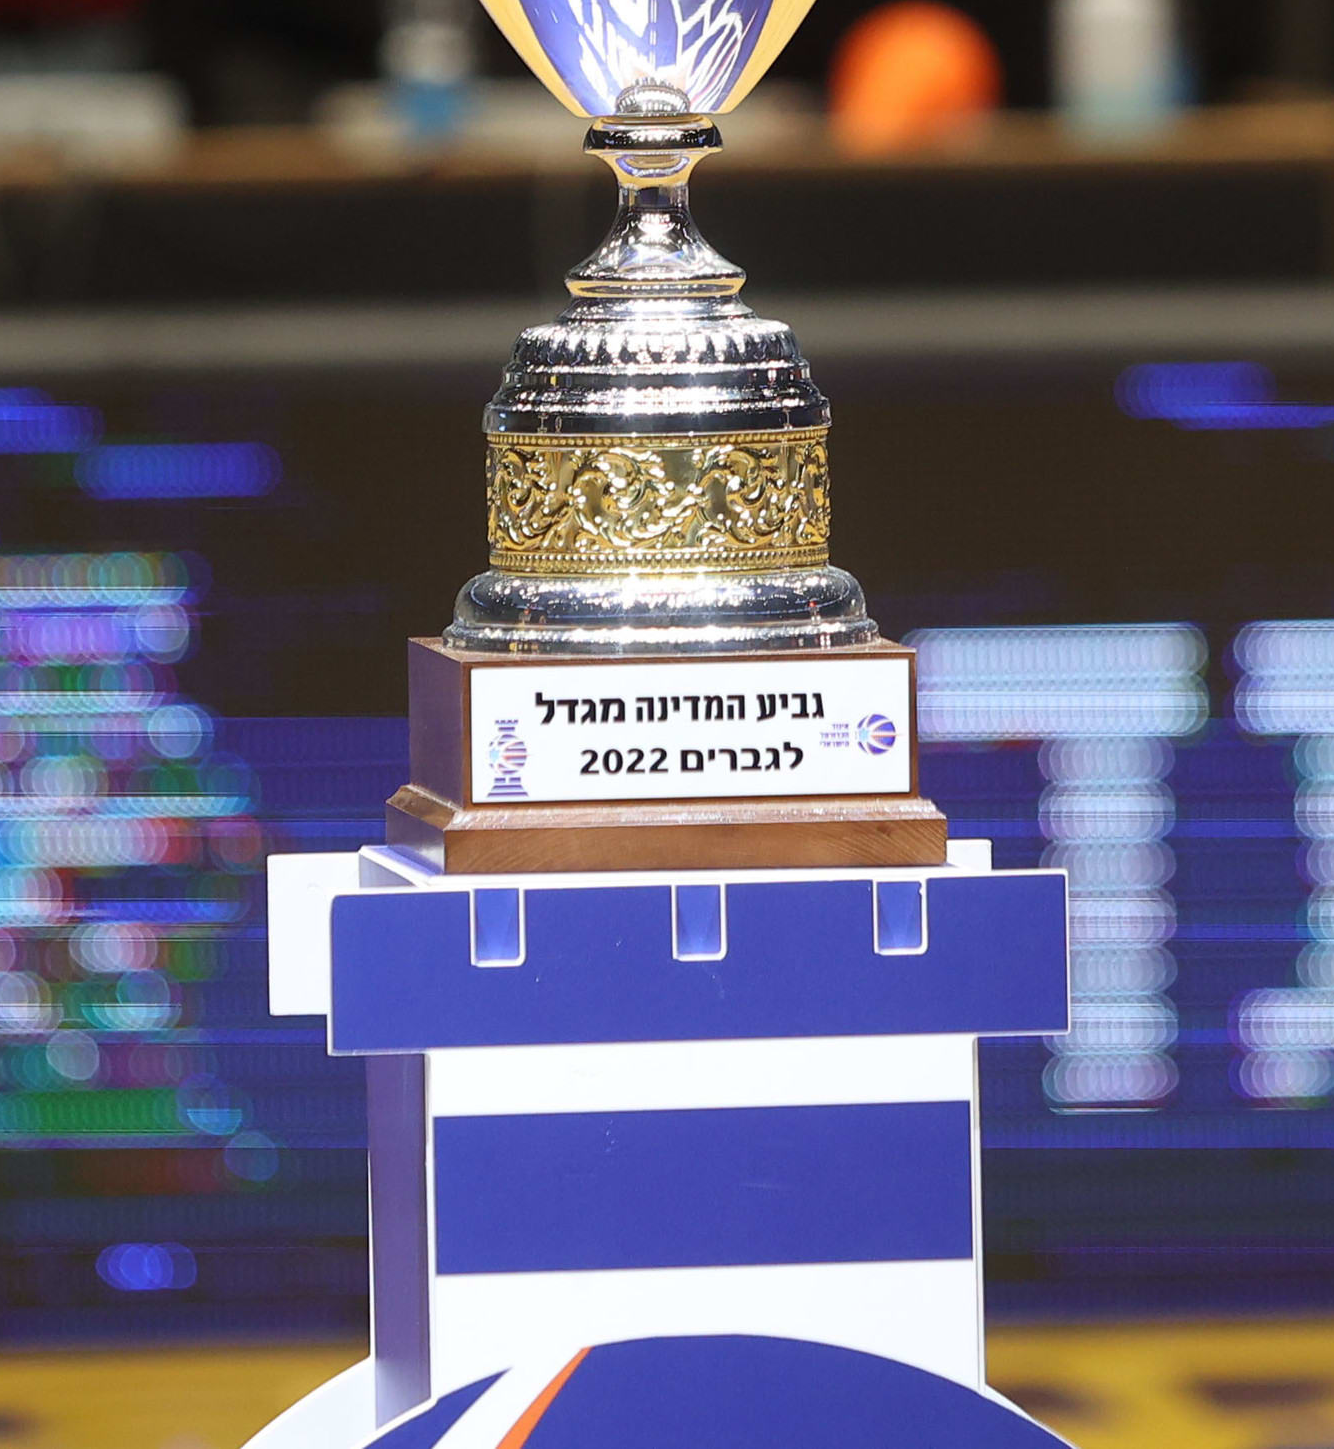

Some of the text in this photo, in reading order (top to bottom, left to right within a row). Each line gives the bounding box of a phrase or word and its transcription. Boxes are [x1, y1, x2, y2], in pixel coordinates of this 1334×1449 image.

[535, 693, 824, 724] גביע המדינה מגדל
[580, 742, 804, 775] לגברים 2022
